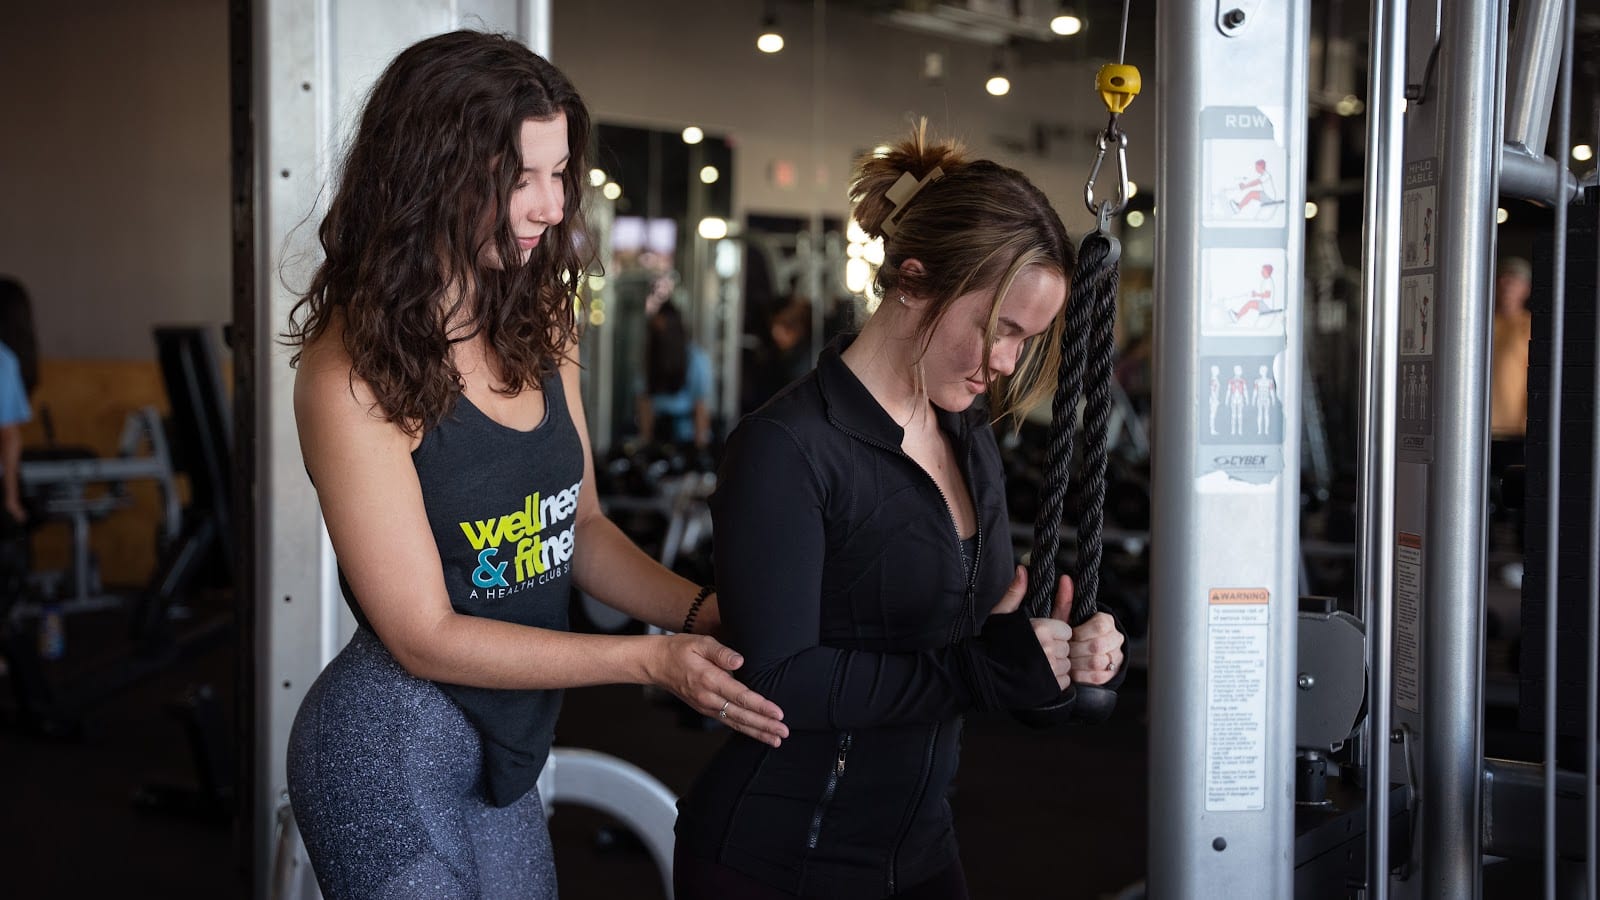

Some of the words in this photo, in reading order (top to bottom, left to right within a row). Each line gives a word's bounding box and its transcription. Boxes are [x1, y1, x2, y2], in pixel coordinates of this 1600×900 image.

[1225, 114, 1266, 129] ROW
[1407, 171, 1433, 185] CABLE
[1230, 455, 1268, 465] CYBEX
[459, 478, 583, 550] wellnes
[471, 547, 510, 588] &
[469, 589, 479, 599] A
[486, 578, 535, 600] HEALTH
[538, 566, 562, 585] CLUB
[1220, 592, 1267, 601] WARNING
